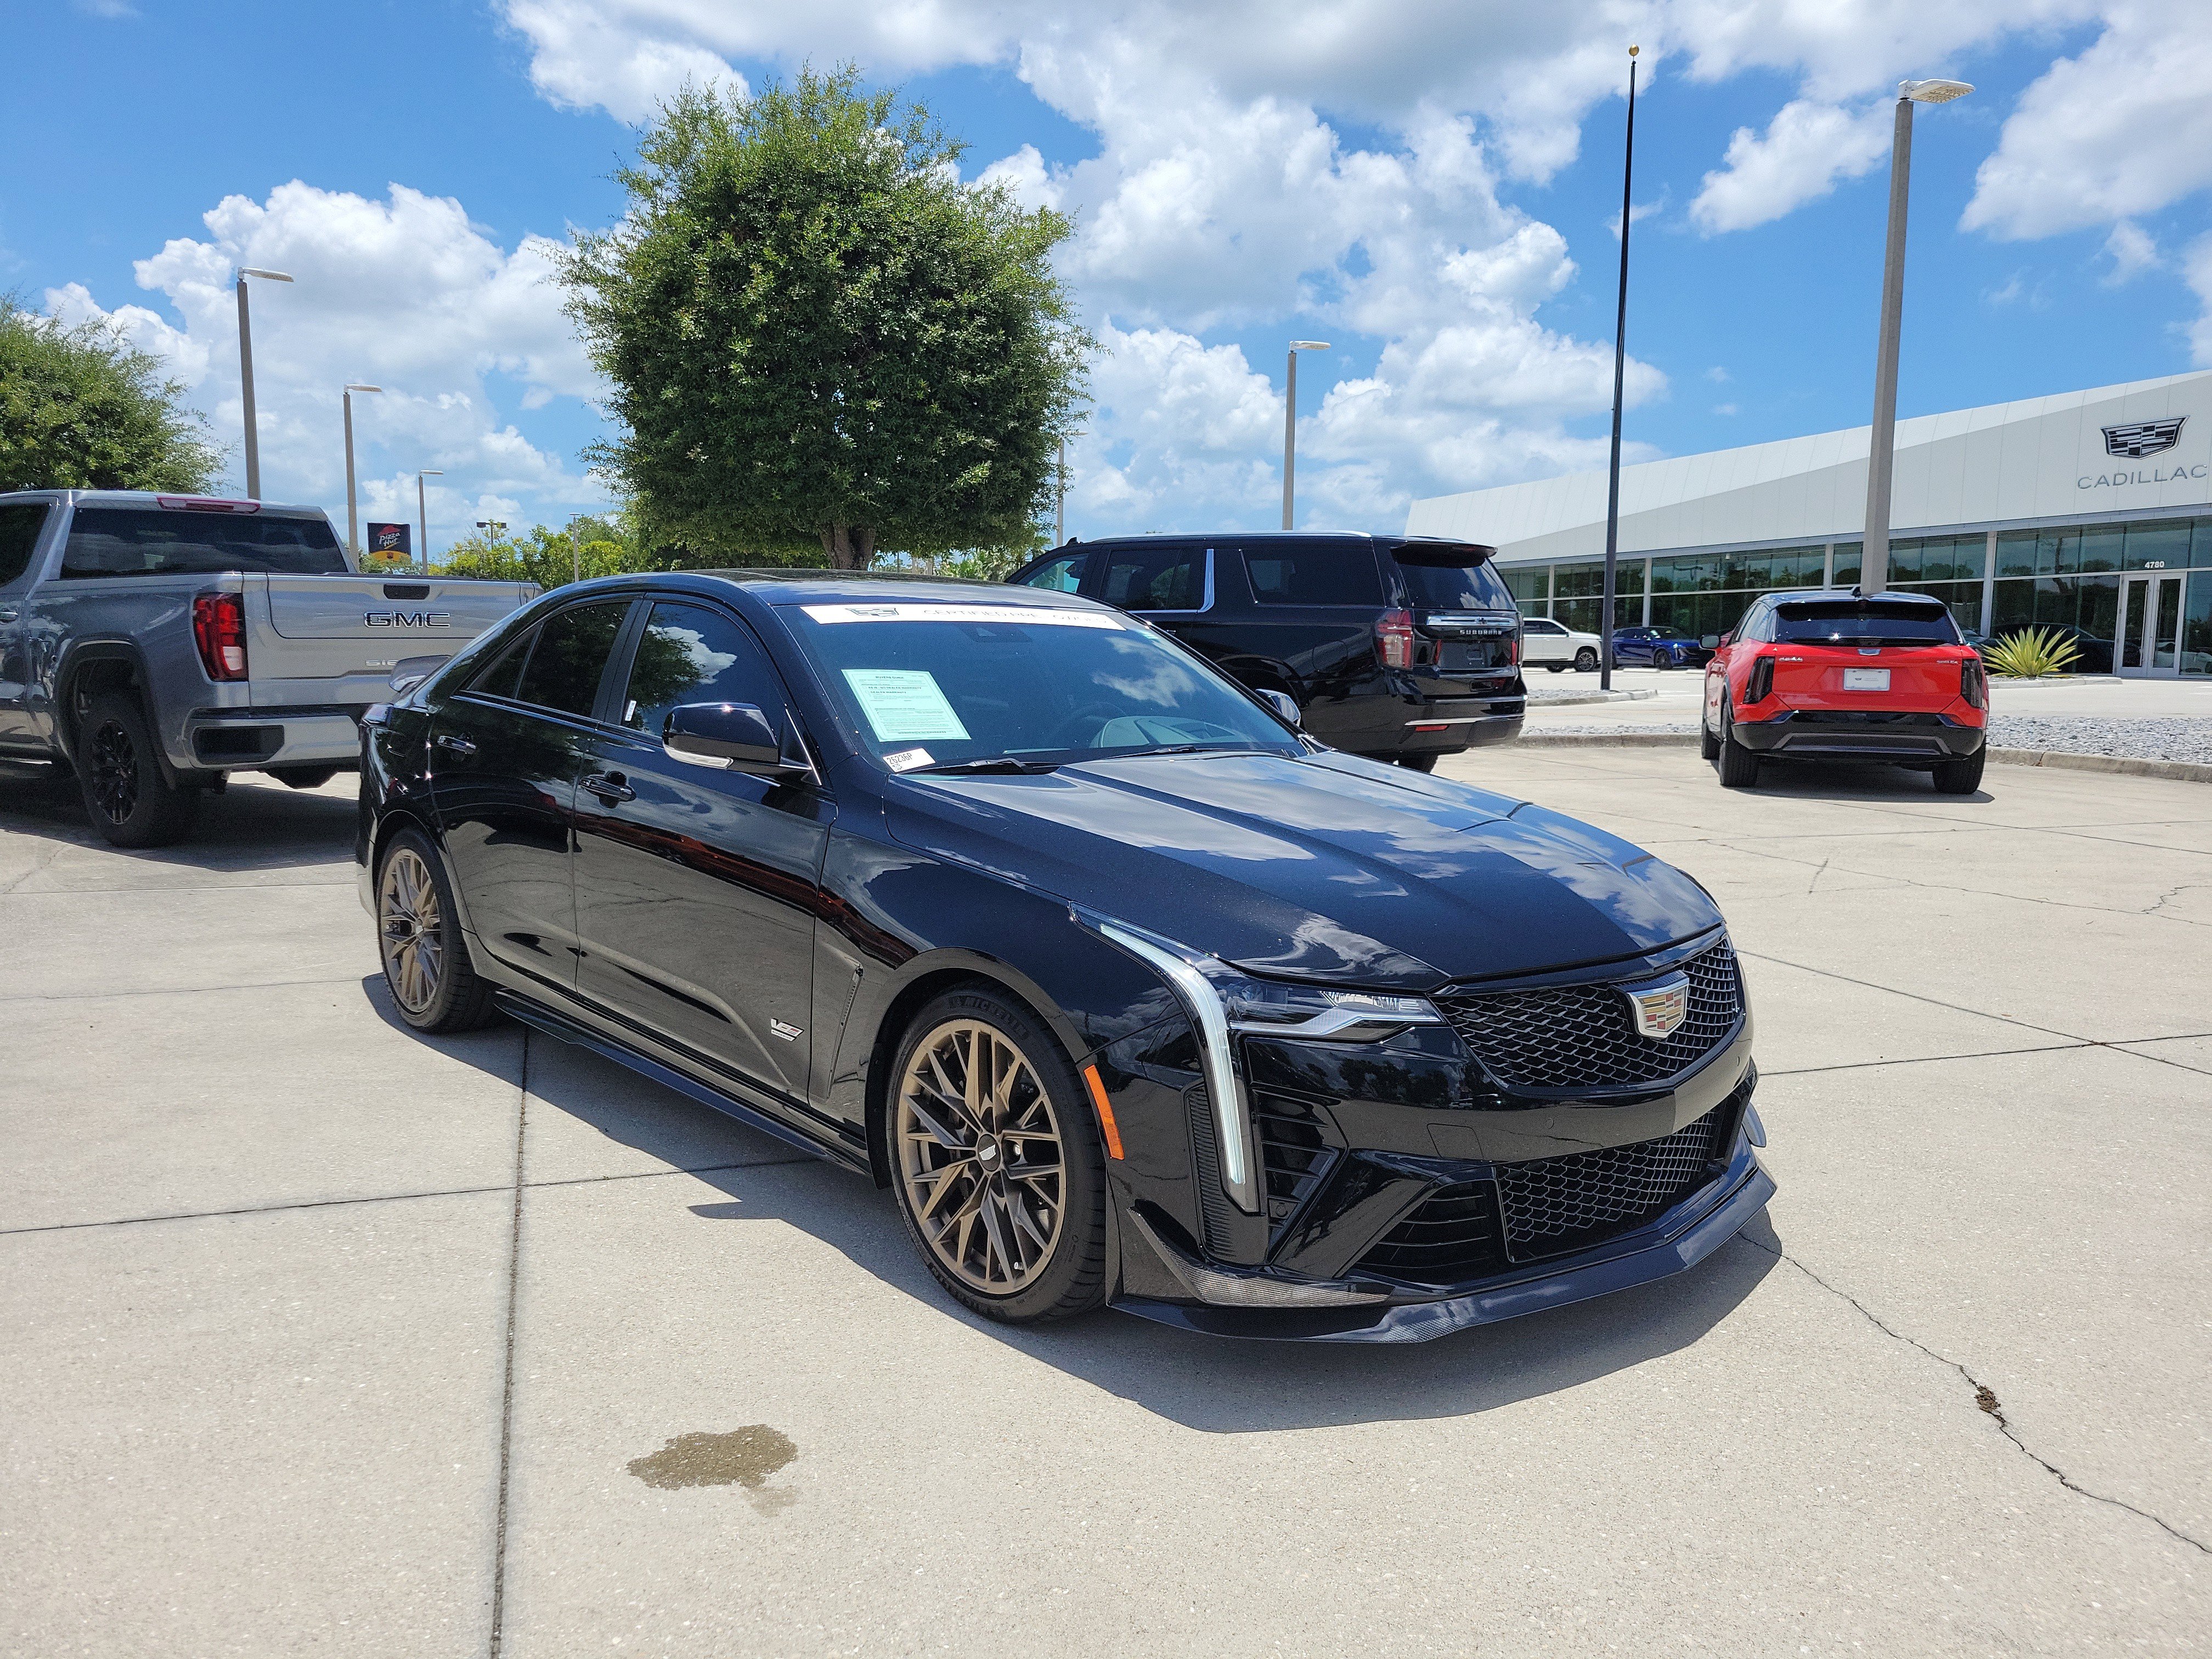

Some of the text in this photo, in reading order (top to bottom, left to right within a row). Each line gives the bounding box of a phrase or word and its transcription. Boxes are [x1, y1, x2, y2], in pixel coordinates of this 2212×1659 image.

[2078, 465, 2208, 489] CADILLAC
[379, 532, 400, 545] Pizza
[383, 538, 399, 547] Hut
[364, 611, 450, 628] GMC
[887, 753, 912, 765] 26236P
